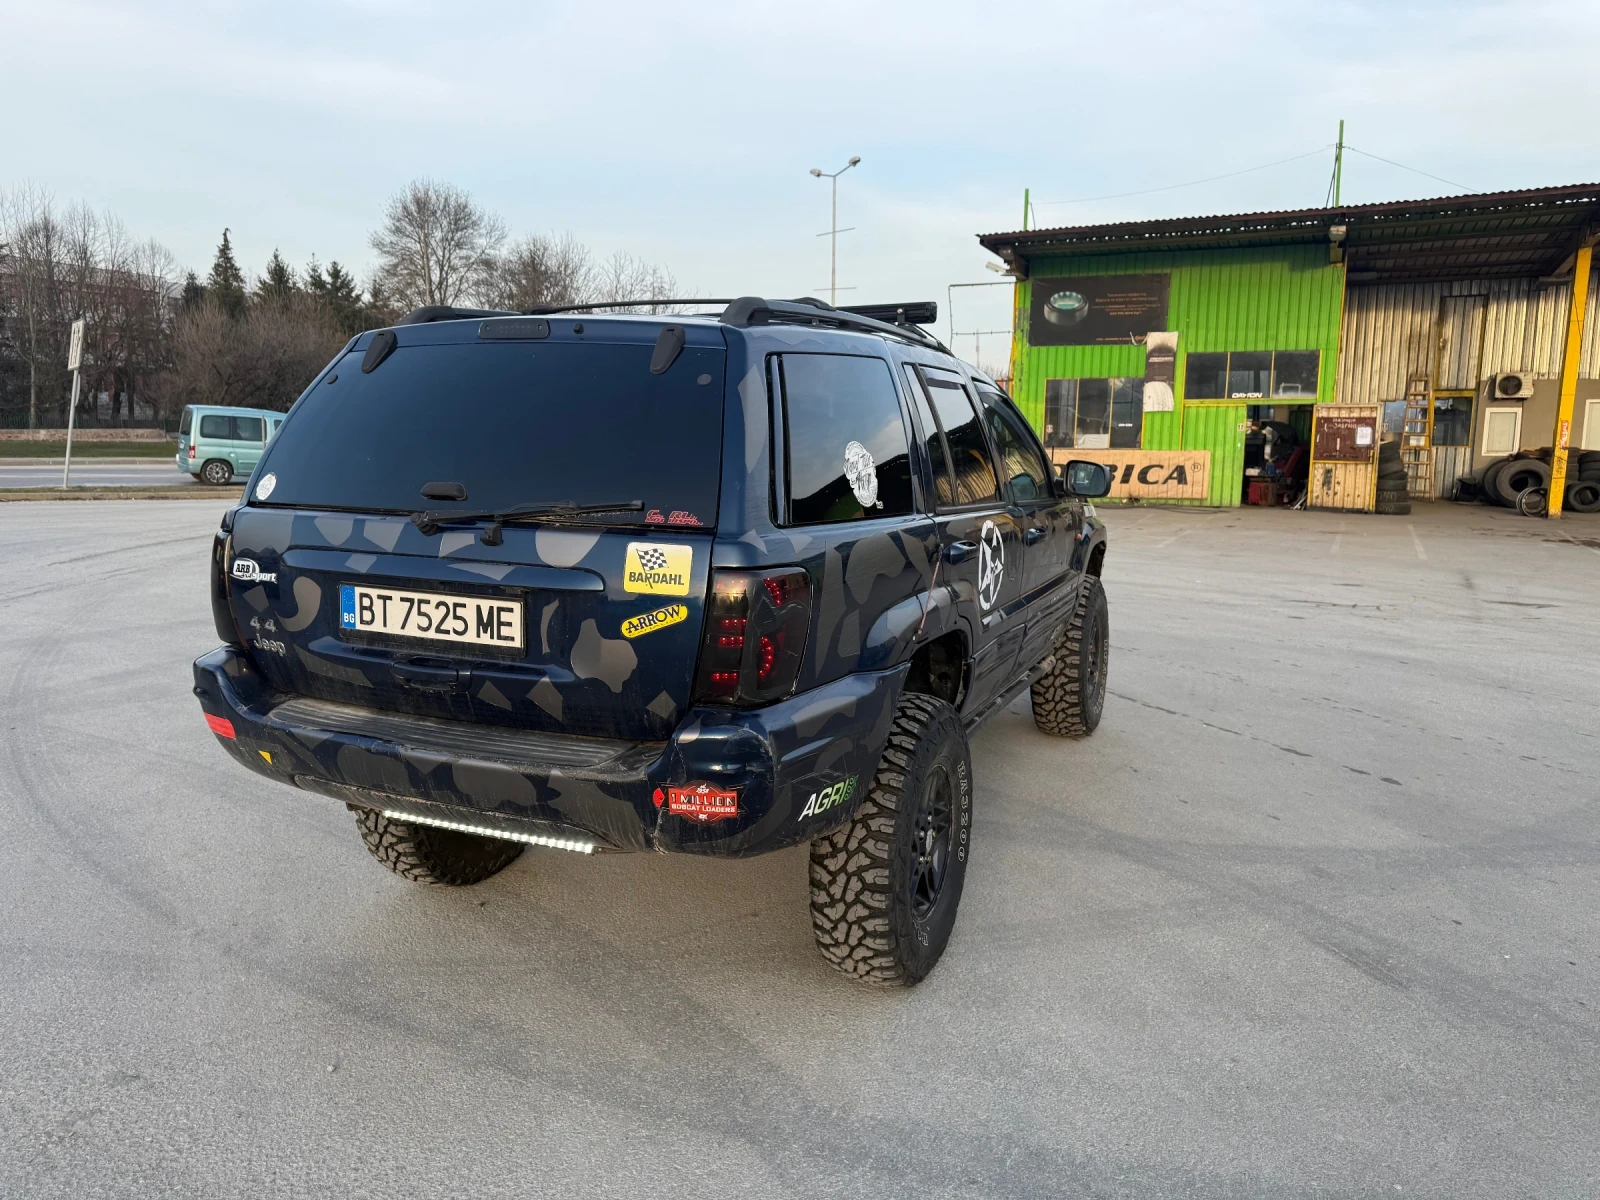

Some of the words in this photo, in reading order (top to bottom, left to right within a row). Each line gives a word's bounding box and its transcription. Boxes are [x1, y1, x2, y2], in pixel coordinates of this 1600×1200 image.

[235, 563, 251, 574] ARB
[628, 571, 685, 586] BARDAHL
[343, 612, 355, 624] BG
[359, 592, 393, 628] BT
[399, 596, 469, 637] 7525
[476, 604, 516, 642] ME
[625, 604, 682, 634] ARROW
[253, 633, 286, 657] Jeep
[671, 793, 676, 803] 1
[680, 794, 736, 806] MILLION
[798, 779, 850, 822] AGRI
[671, 803, 701, 811] BOBCAT
[702, 805, 736, 813] LOADERS
